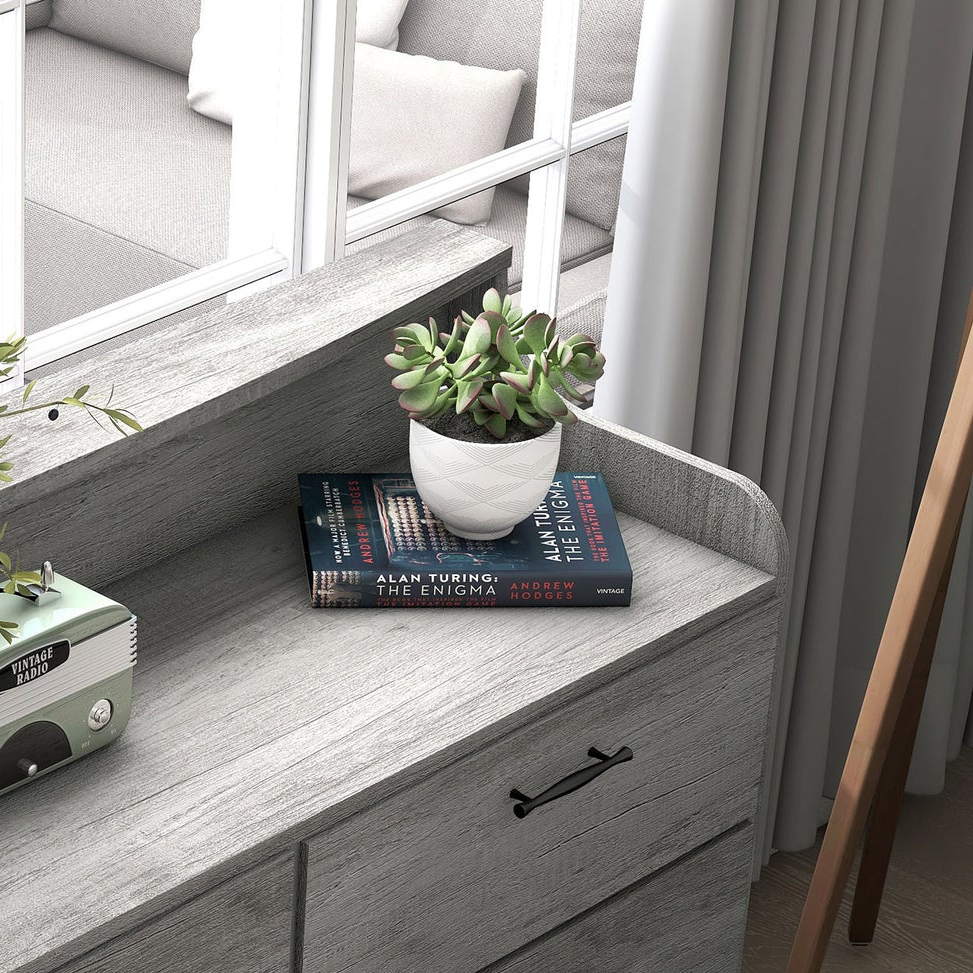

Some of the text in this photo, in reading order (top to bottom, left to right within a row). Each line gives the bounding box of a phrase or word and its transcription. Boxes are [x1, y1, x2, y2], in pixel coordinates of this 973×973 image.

[323, 482, 333, 507] STARRING
[578, 480, 592, 500] GAME
[348, 481, 374, 563] ANDREW HODGES
[549, 480, 584, 562] THE ENIGMA
[585, 504, 604, 543] IMITATION
[330, 524, 339, 542] MAJOR
[335, 550, 343, 563] NOW
[538, 532, 562, 562] ALAN
[598, 547, 610, 562] THE
[376, 574, 498, 583] ALAN TURING:
[510, 582, 574, 590] ANDREW
[376, 585, 496, 596] THE ENIGMA
[510, 592, 573, 600] HODGES
[11, 647, 53, 675] VINTAGE
[17, 662, 48, 685] RADIO
